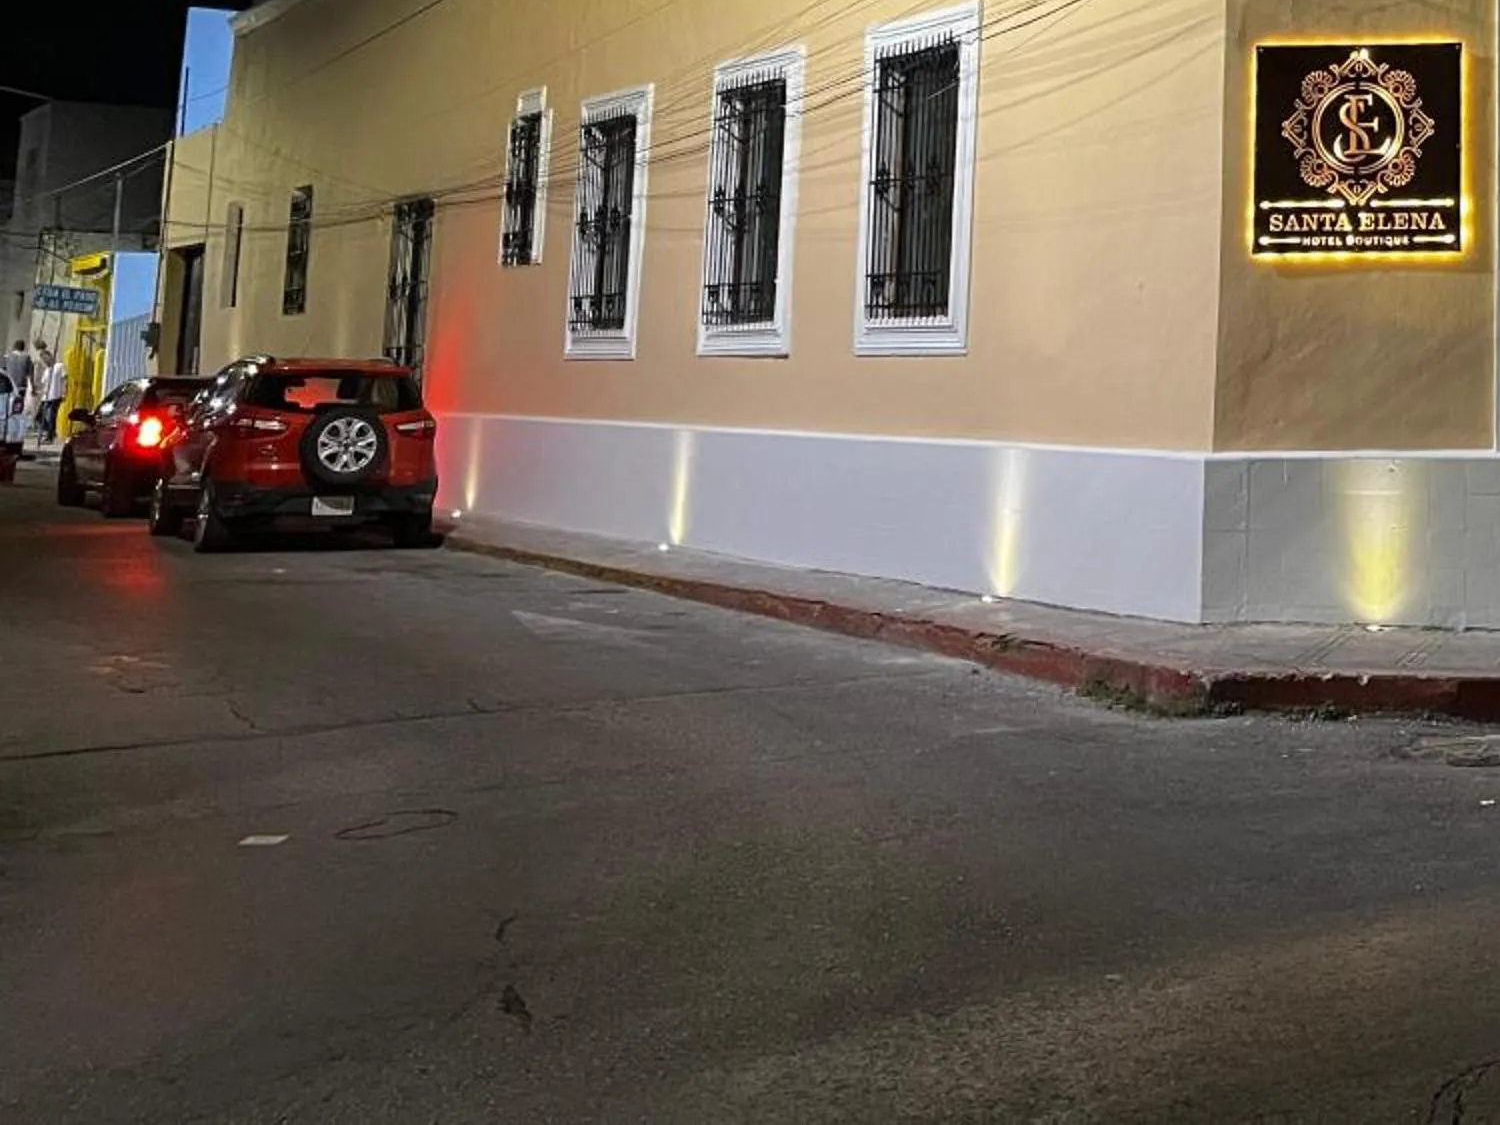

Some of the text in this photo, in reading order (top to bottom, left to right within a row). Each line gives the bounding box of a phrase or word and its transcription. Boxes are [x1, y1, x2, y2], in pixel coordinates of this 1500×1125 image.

[1268, 211, 1447, 232] SANTA ELENA
[1302, 236, 1342, 247] HOTEL
